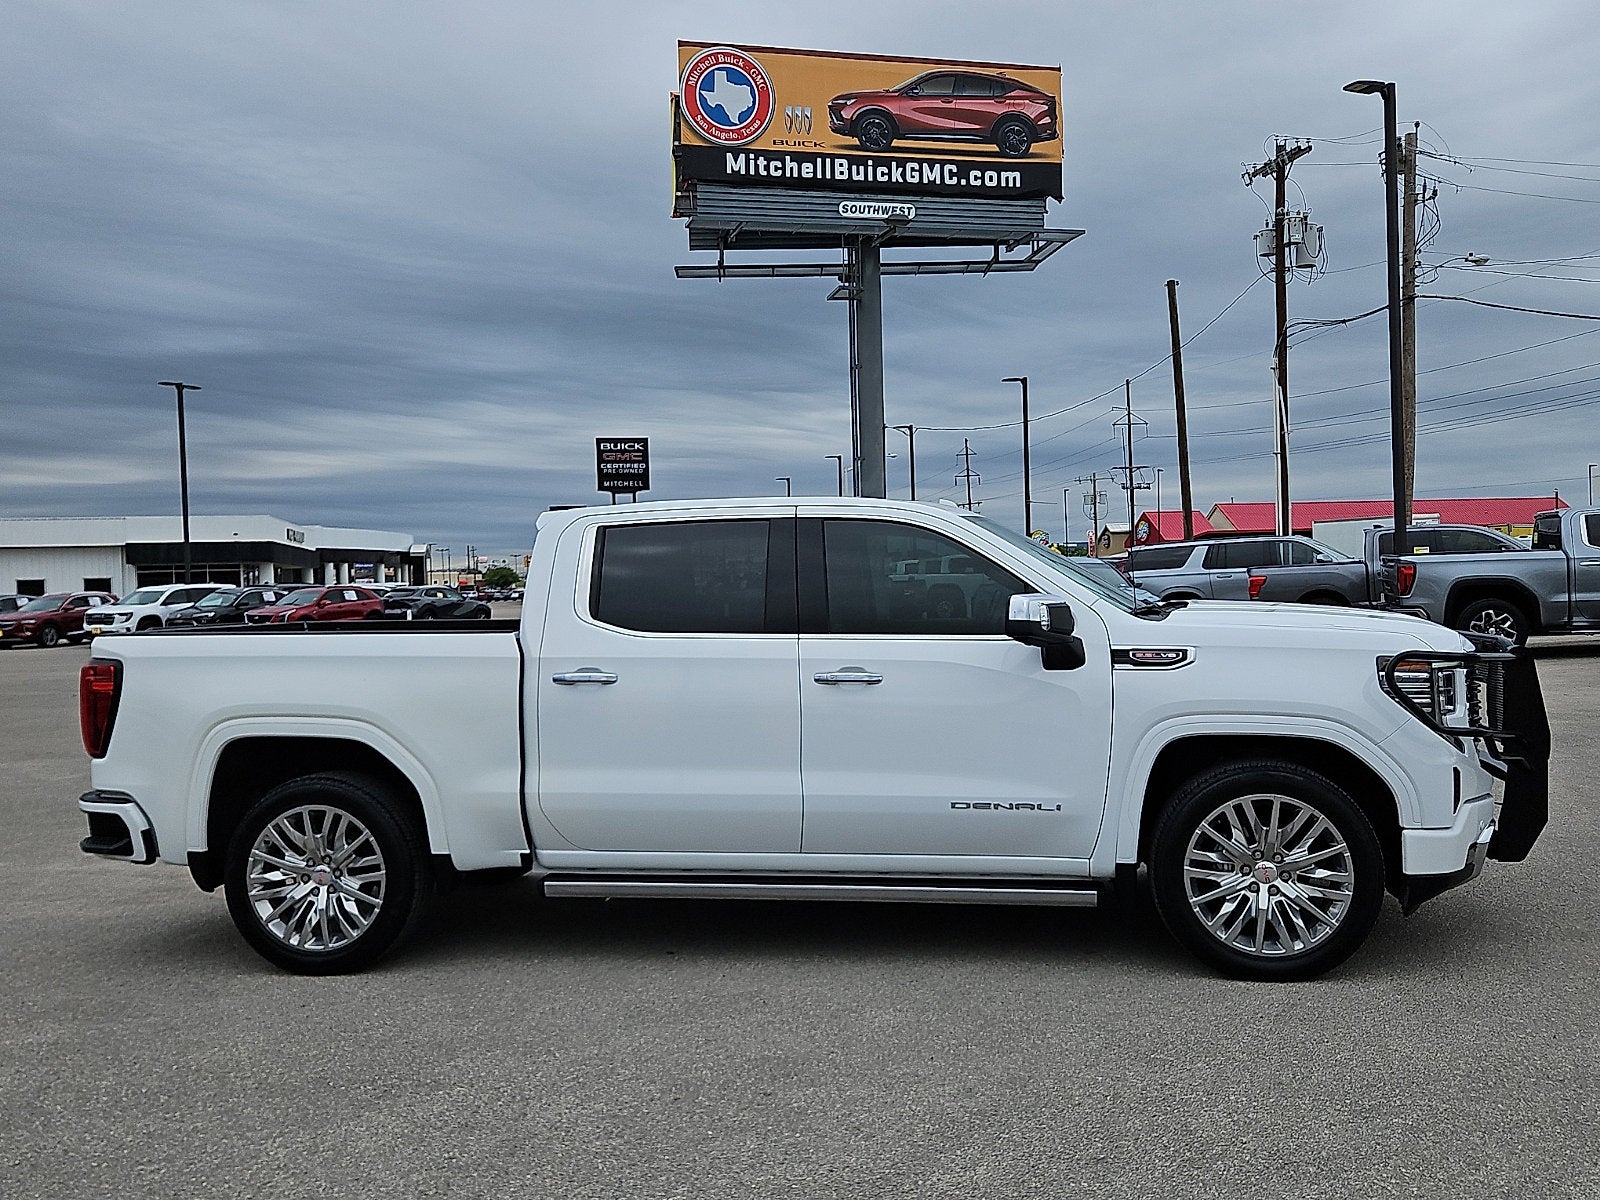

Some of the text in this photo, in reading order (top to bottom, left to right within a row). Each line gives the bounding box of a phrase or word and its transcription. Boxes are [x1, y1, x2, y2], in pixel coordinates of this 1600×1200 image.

[688, 56, 716, 86] Mitchell
[718, 54, 745, 67] Buick
[750, 68, 767, 92] GMC
[695, 114, 761, 140] San Angelo, Texas
[772, 140, 826, 149] BUICK
[725, 153, 1021, 187] MitchellBuickGMC.com
[841, 203, 914, 217] SOUTHWEST
[603, 452, 642, 460] GMC
[950, 801, 1062, 811] DENALI
